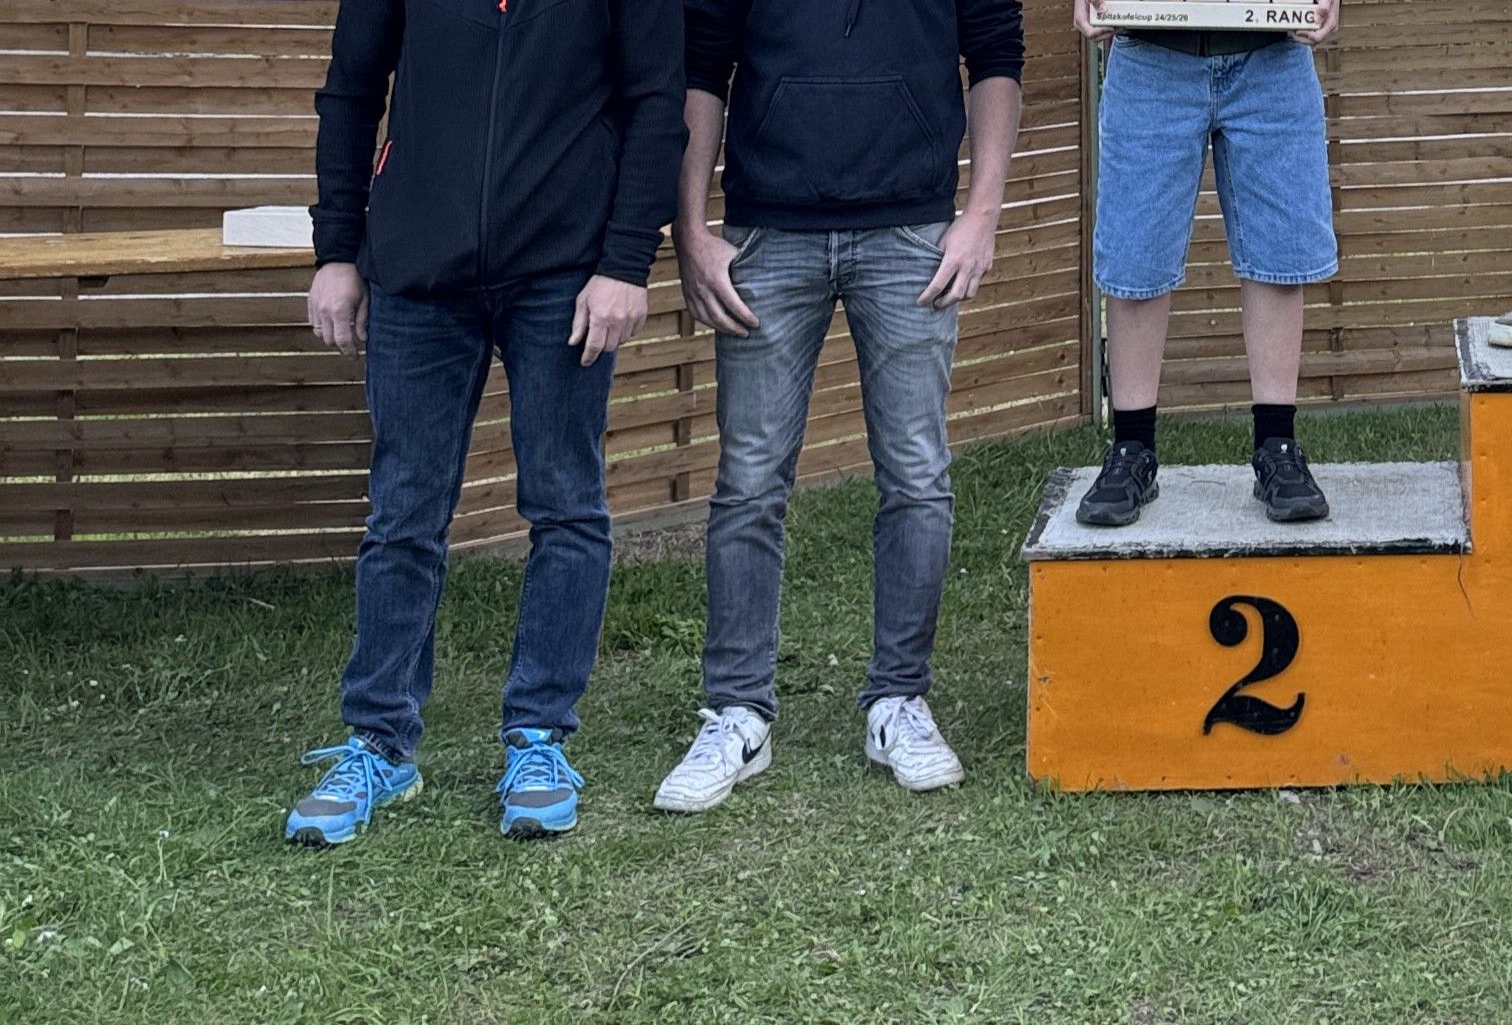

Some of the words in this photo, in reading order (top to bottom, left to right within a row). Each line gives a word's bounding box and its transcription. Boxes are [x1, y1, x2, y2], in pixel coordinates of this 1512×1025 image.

[1245, 9, 1259, 23] 2.
[1266, 10, 1316, 24] RANG
[1203, 595, 1305, 736] 2
